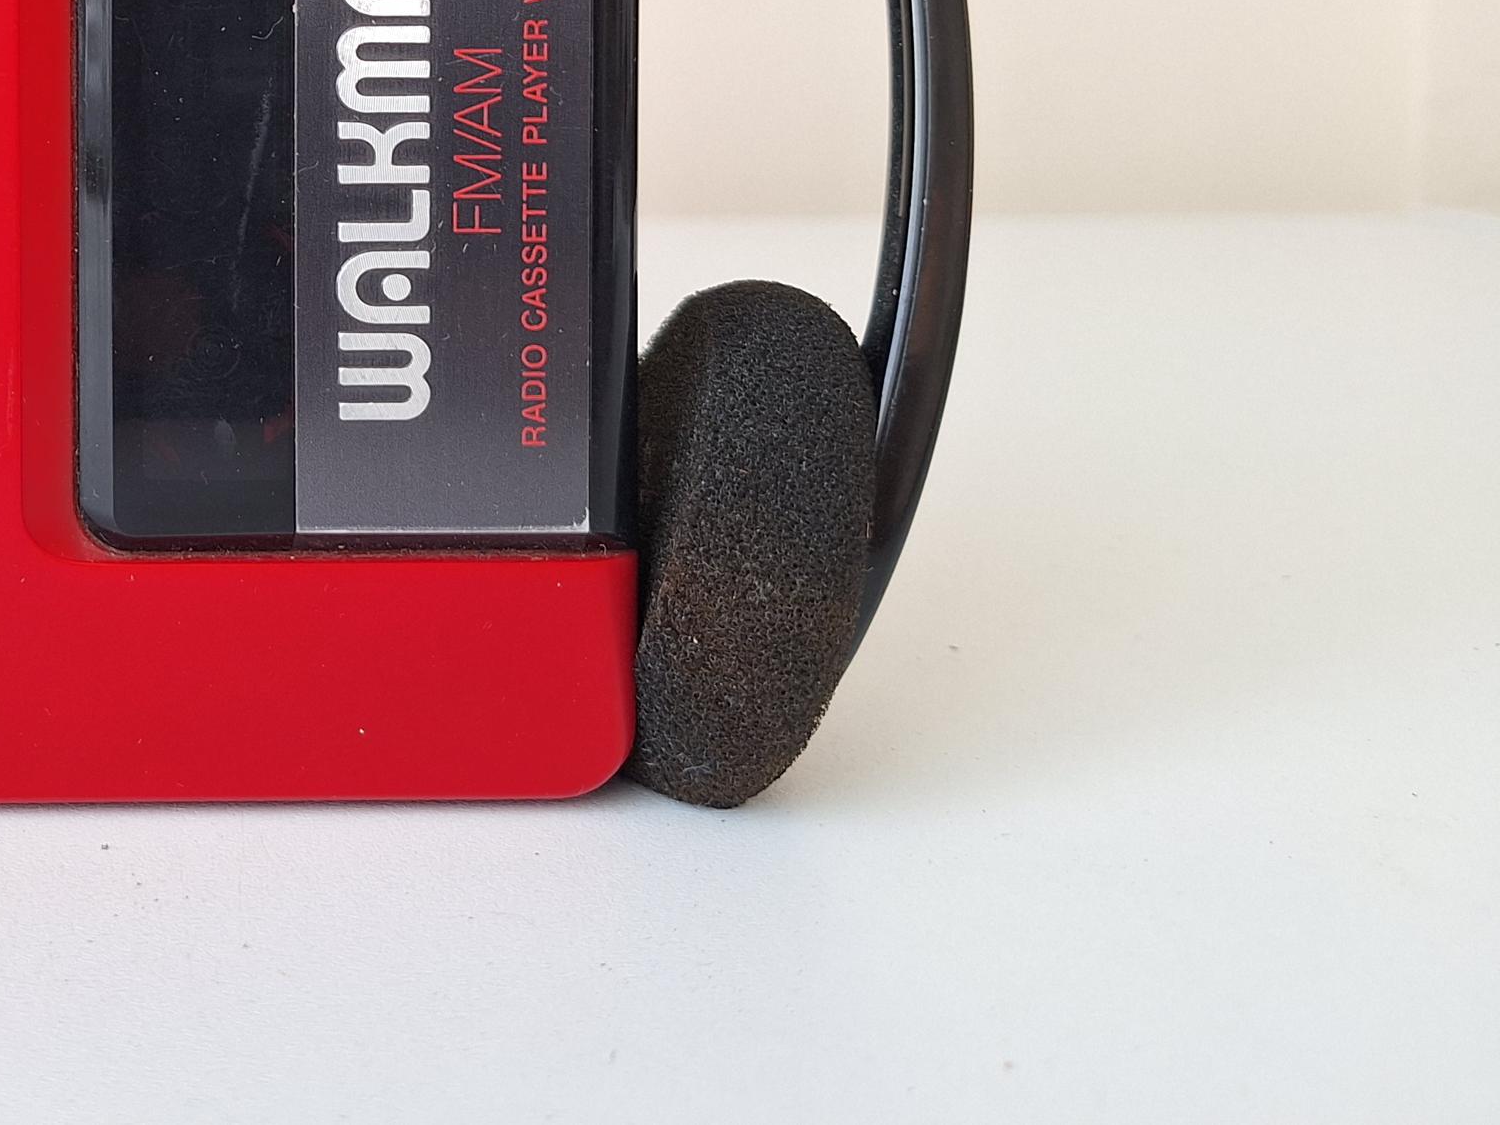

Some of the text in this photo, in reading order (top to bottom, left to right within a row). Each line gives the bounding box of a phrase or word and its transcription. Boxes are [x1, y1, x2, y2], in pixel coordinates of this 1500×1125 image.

[451, 47, 504, 235] FM/AM
[521, 19, 550, 146] PLAYER
[520, 163, 549, 332] CASSETTE
[520, 343, 549, 448] RADIO
